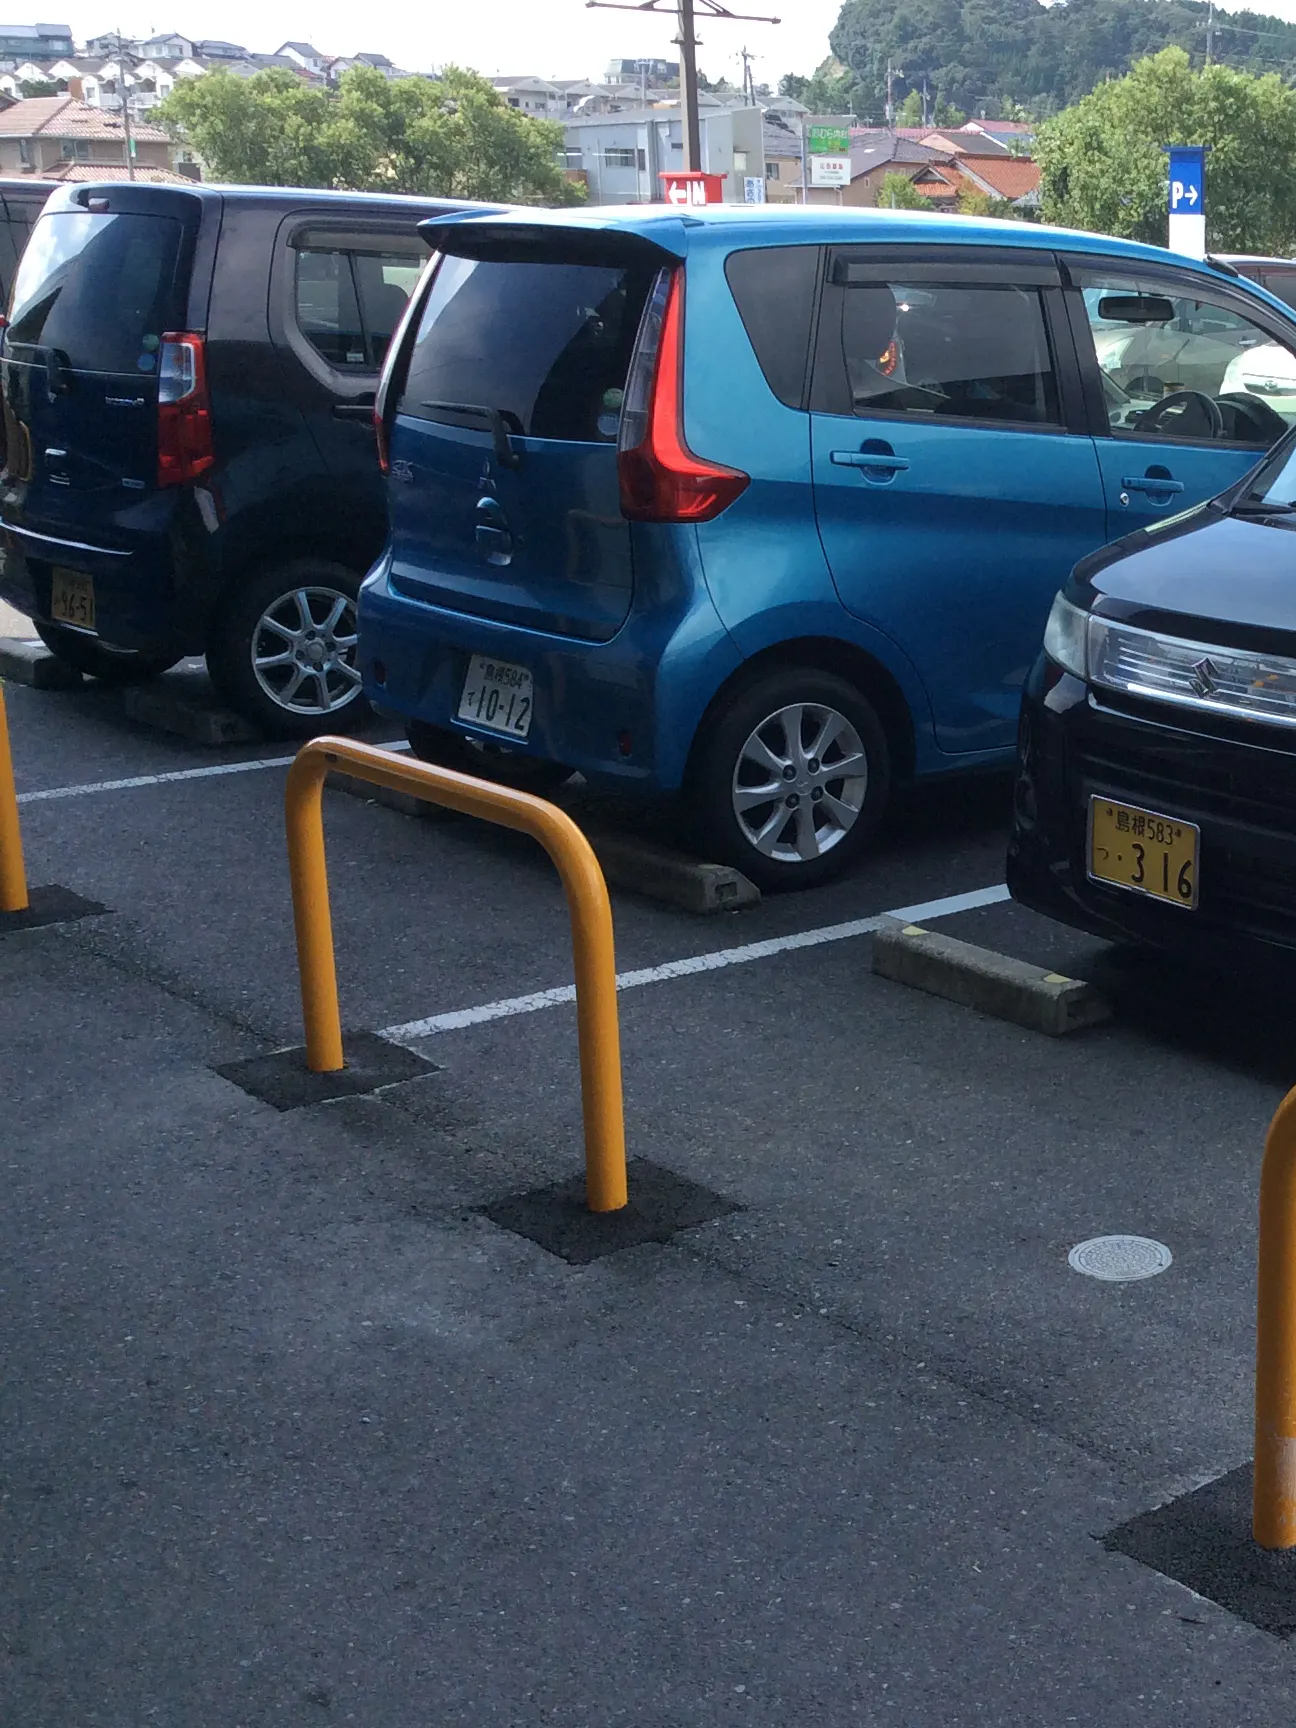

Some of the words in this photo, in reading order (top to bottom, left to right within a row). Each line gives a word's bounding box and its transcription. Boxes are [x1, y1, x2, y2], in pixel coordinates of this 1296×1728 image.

[686, 181, 706, 205] IN
[1172, 181, 1184, 209] P
[476, 686, 530, 730] 10-12
